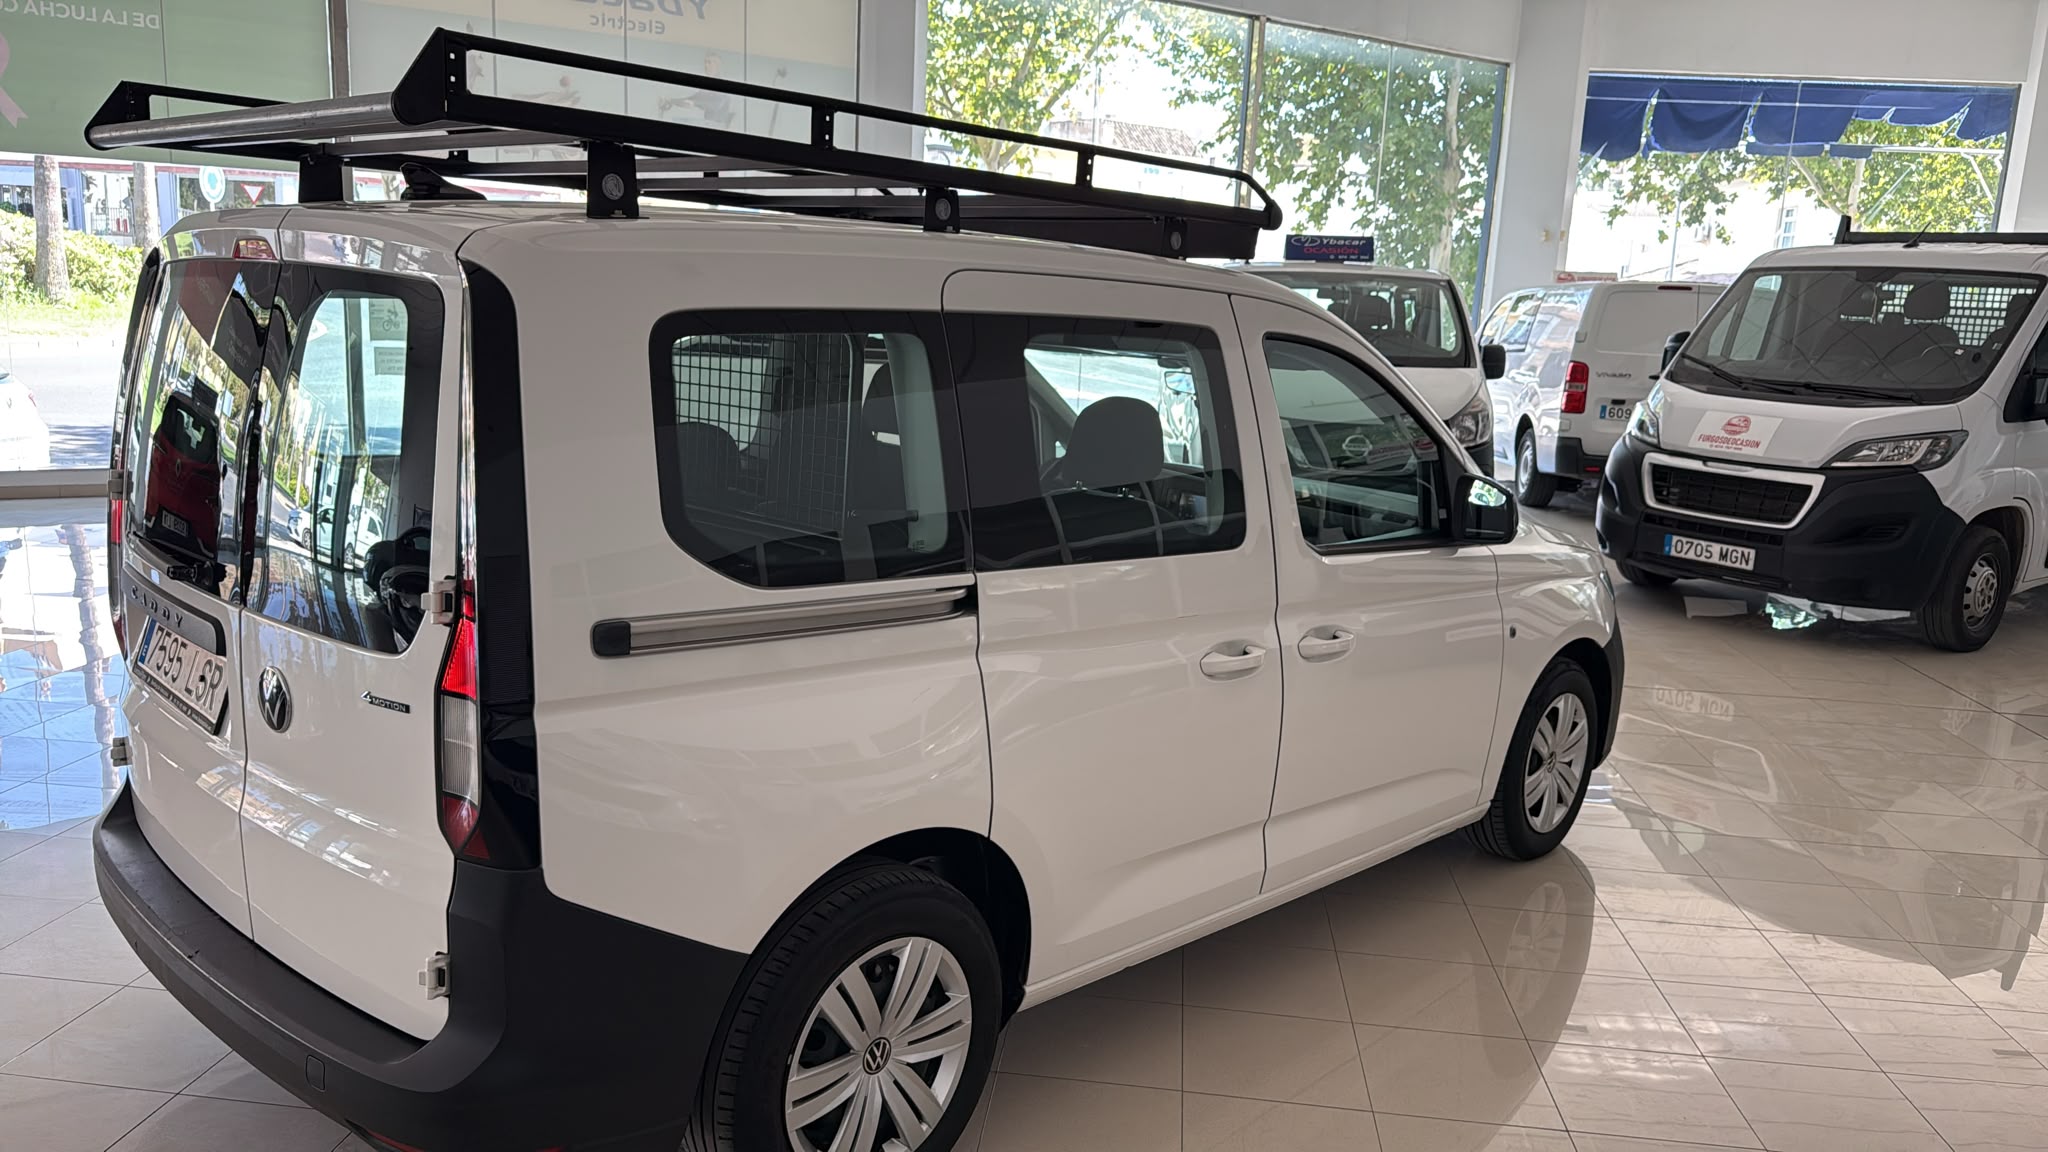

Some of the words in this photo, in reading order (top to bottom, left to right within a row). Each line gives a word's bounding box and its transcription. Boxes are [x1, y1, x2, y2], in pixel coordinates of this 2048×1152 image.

[1322, 238, 1366, 246] Ybacar
[1674, 539, 1713, 560] 0705
[1718, 546, 1751, 567] MGN
[130, 585, 184, 628] CADDY
[147, 625, 188, 684] 7595
[184, 650, 224, 711] LSR
[361, 690, 406, 712] 4MOTION
